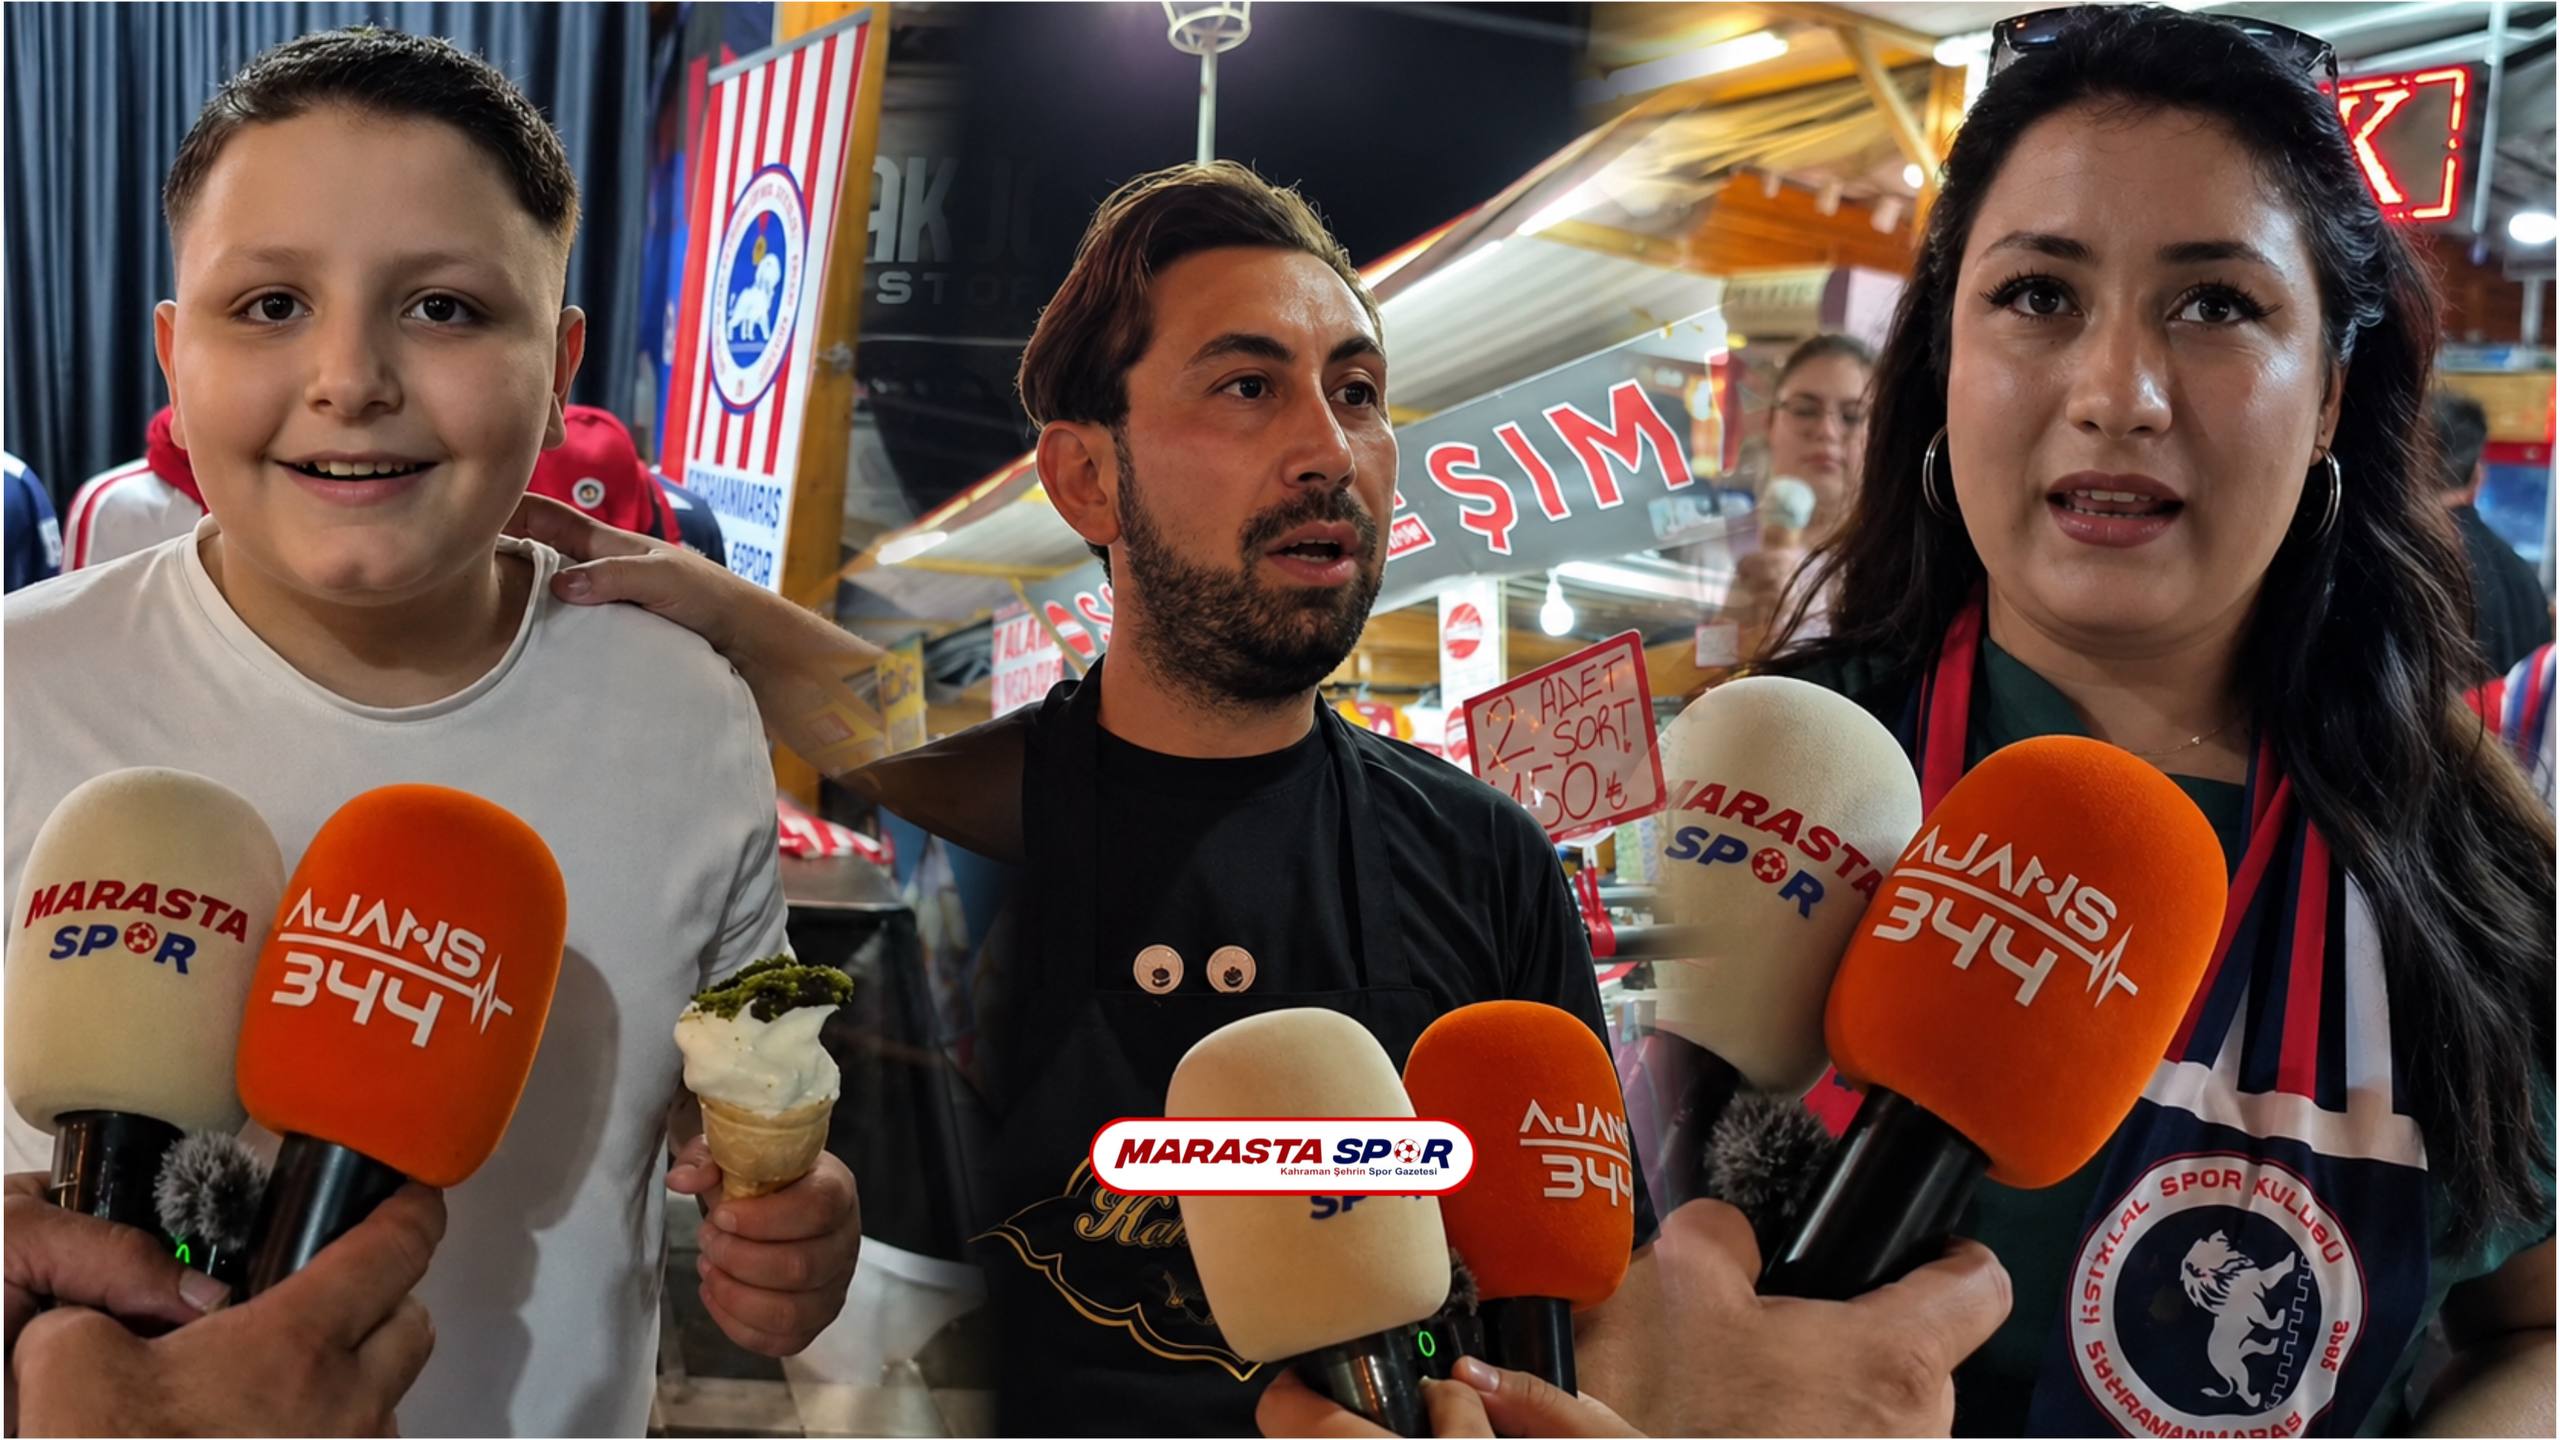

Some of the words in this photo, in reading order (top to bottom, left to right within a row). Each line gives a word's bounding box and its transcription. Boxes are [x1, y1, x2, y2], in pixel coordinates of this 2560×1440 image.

[1486, 694, 1535, 771] 2
[1540, 653, 1625, 725] ADET
[24, 880, 249, 944] MARASTA
[1904, 824, 2119, 943] AJANS
[284, 886, 487, 979] AJANS
[1872, 886, 2059, 1008] 344
[271, 951, 445, 1048] 344
[2160, 1168, 2242, 1197] SPOR
